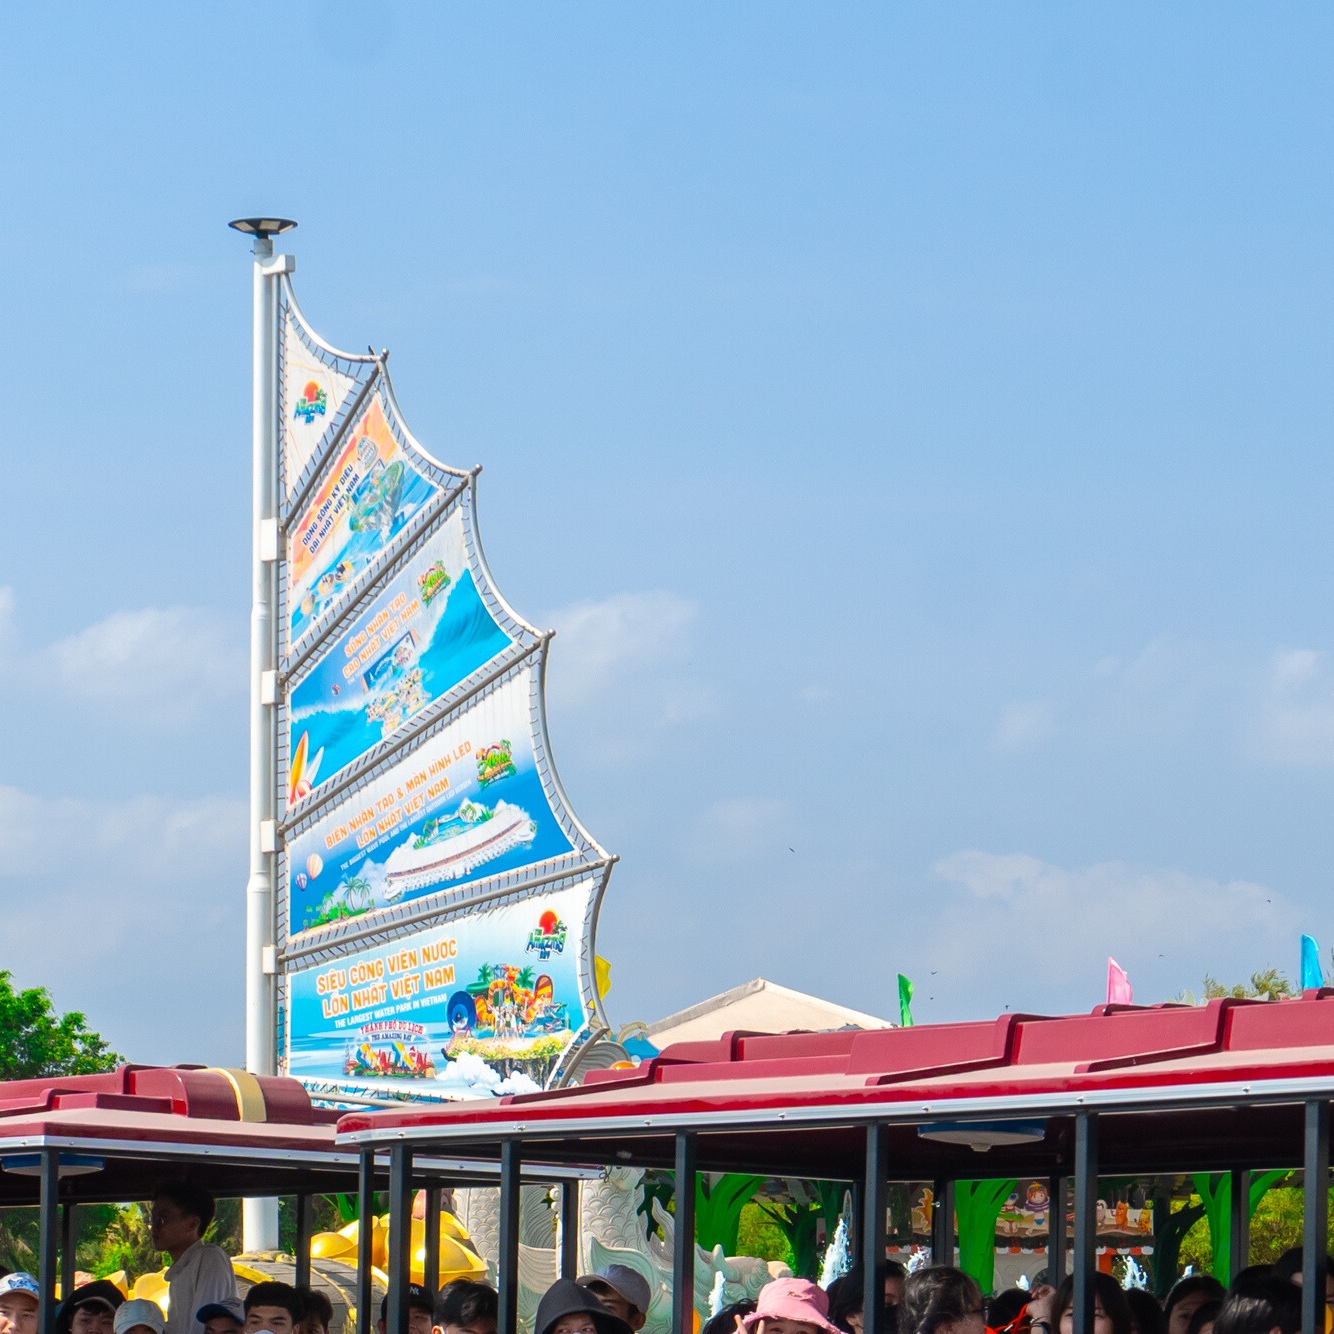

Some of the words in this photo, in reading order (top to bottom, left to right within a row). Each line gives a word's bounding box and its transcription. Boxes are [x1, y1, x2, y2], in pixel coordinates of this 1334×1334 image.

[399, 599, 420, 623] NAM
[396, 787, 404, 800] &
[452, 740, 472, 762] LED
[427, 777, 450, 800] NAM
[317, 969, 346, 994] SIÊU
[349, 959, 384, 985] CÔNG
[387, 948, 418, 975] VIÊN
[425, 965, 455, 990] NAM
[334, 1018, 346, 1029] THE
[347, 1013, 373, 1026] LARGEST
[374, 1008, 396, 1020] WATER
[396, 1002, 412, 1015] PARK
[413, 1000, 420, 1010] IN
[420, 993, 447, 1008] VIETNAM
